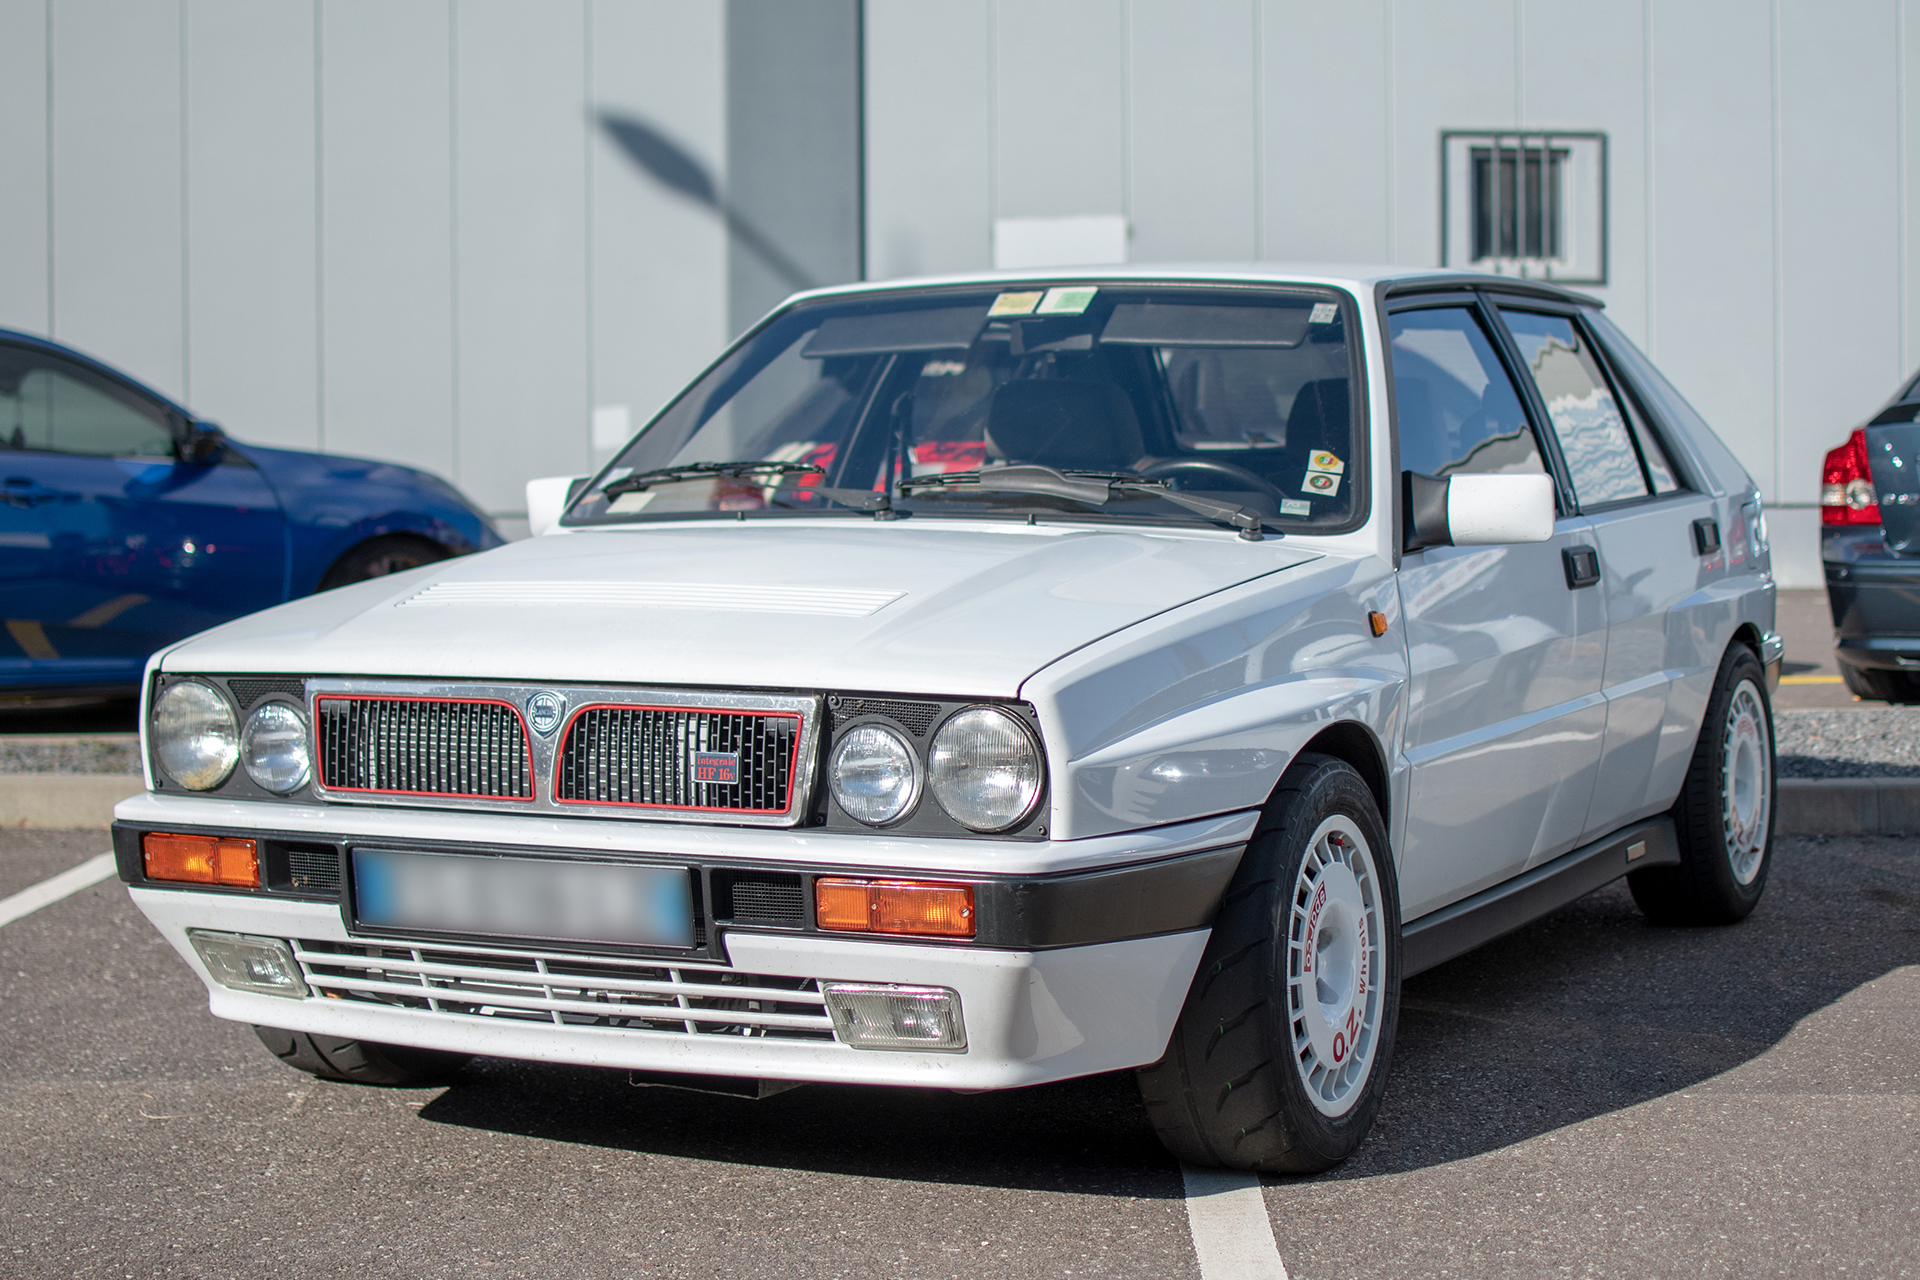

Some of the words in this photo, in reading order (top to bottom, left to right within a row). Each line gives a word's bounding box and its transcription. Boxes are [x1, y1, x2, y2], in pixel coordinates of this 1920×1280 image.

[697, 755, 736, 766] integrale
[697, 766, 716, 780] HF
[1358, 917, 1367, 994] Wheels
